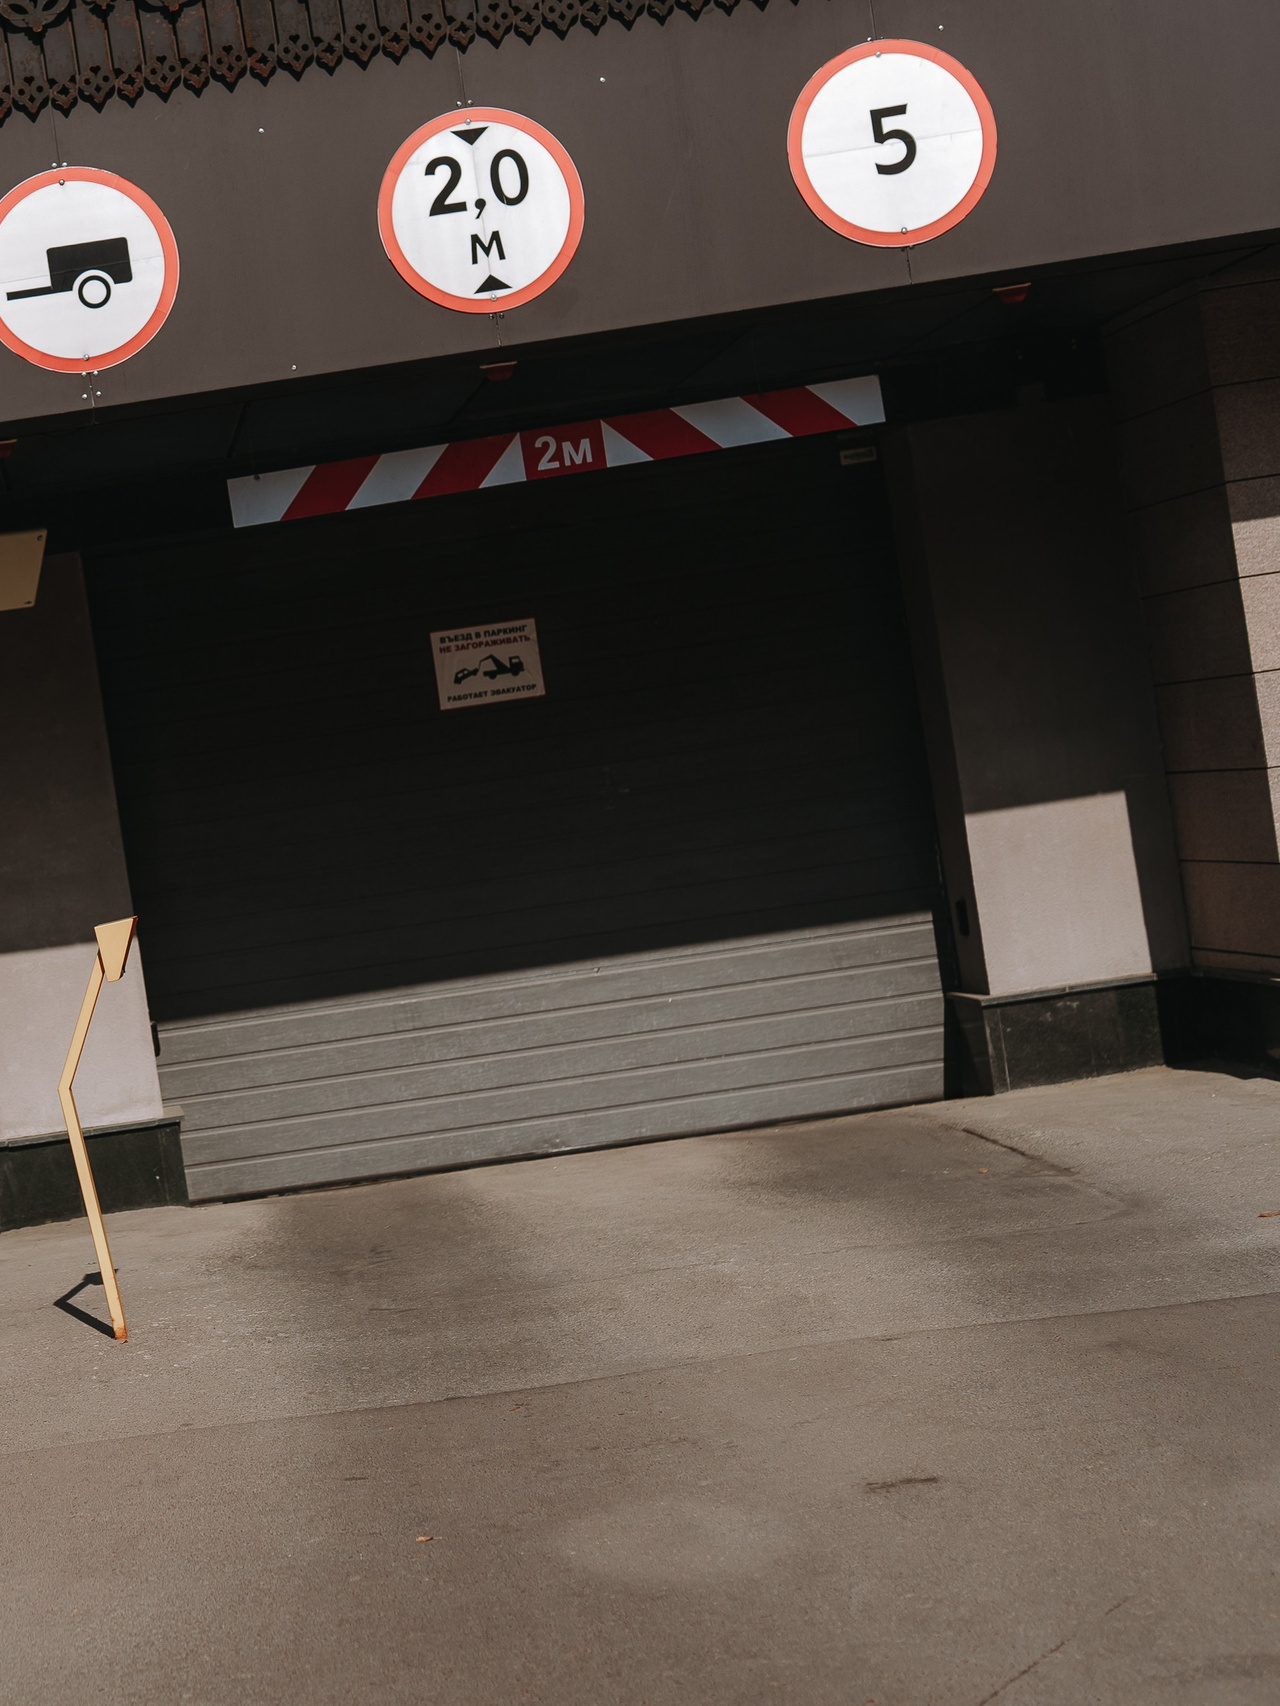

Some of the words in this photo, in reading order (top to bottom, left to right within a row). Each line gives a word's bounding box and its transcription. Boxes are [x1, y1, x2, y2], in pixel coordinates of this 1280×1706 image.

[870, 103, 917, 175] 5
[424, 149, 529, 219] 2,0
[439, 632, 473, 644] ВЪЕЗД
[475, 631, 482, 639] В
[484, 625, 527, 637] ПАРКИНГ
[439, 645, 452, 654] НЕ
[454, 635, 531, 652] ЗАГОРАЖИВАТЬ
[447, 691, 488, 702] РАБОТАЕТ
[490, 684, 537, 696] ЭВАКУАТОР
